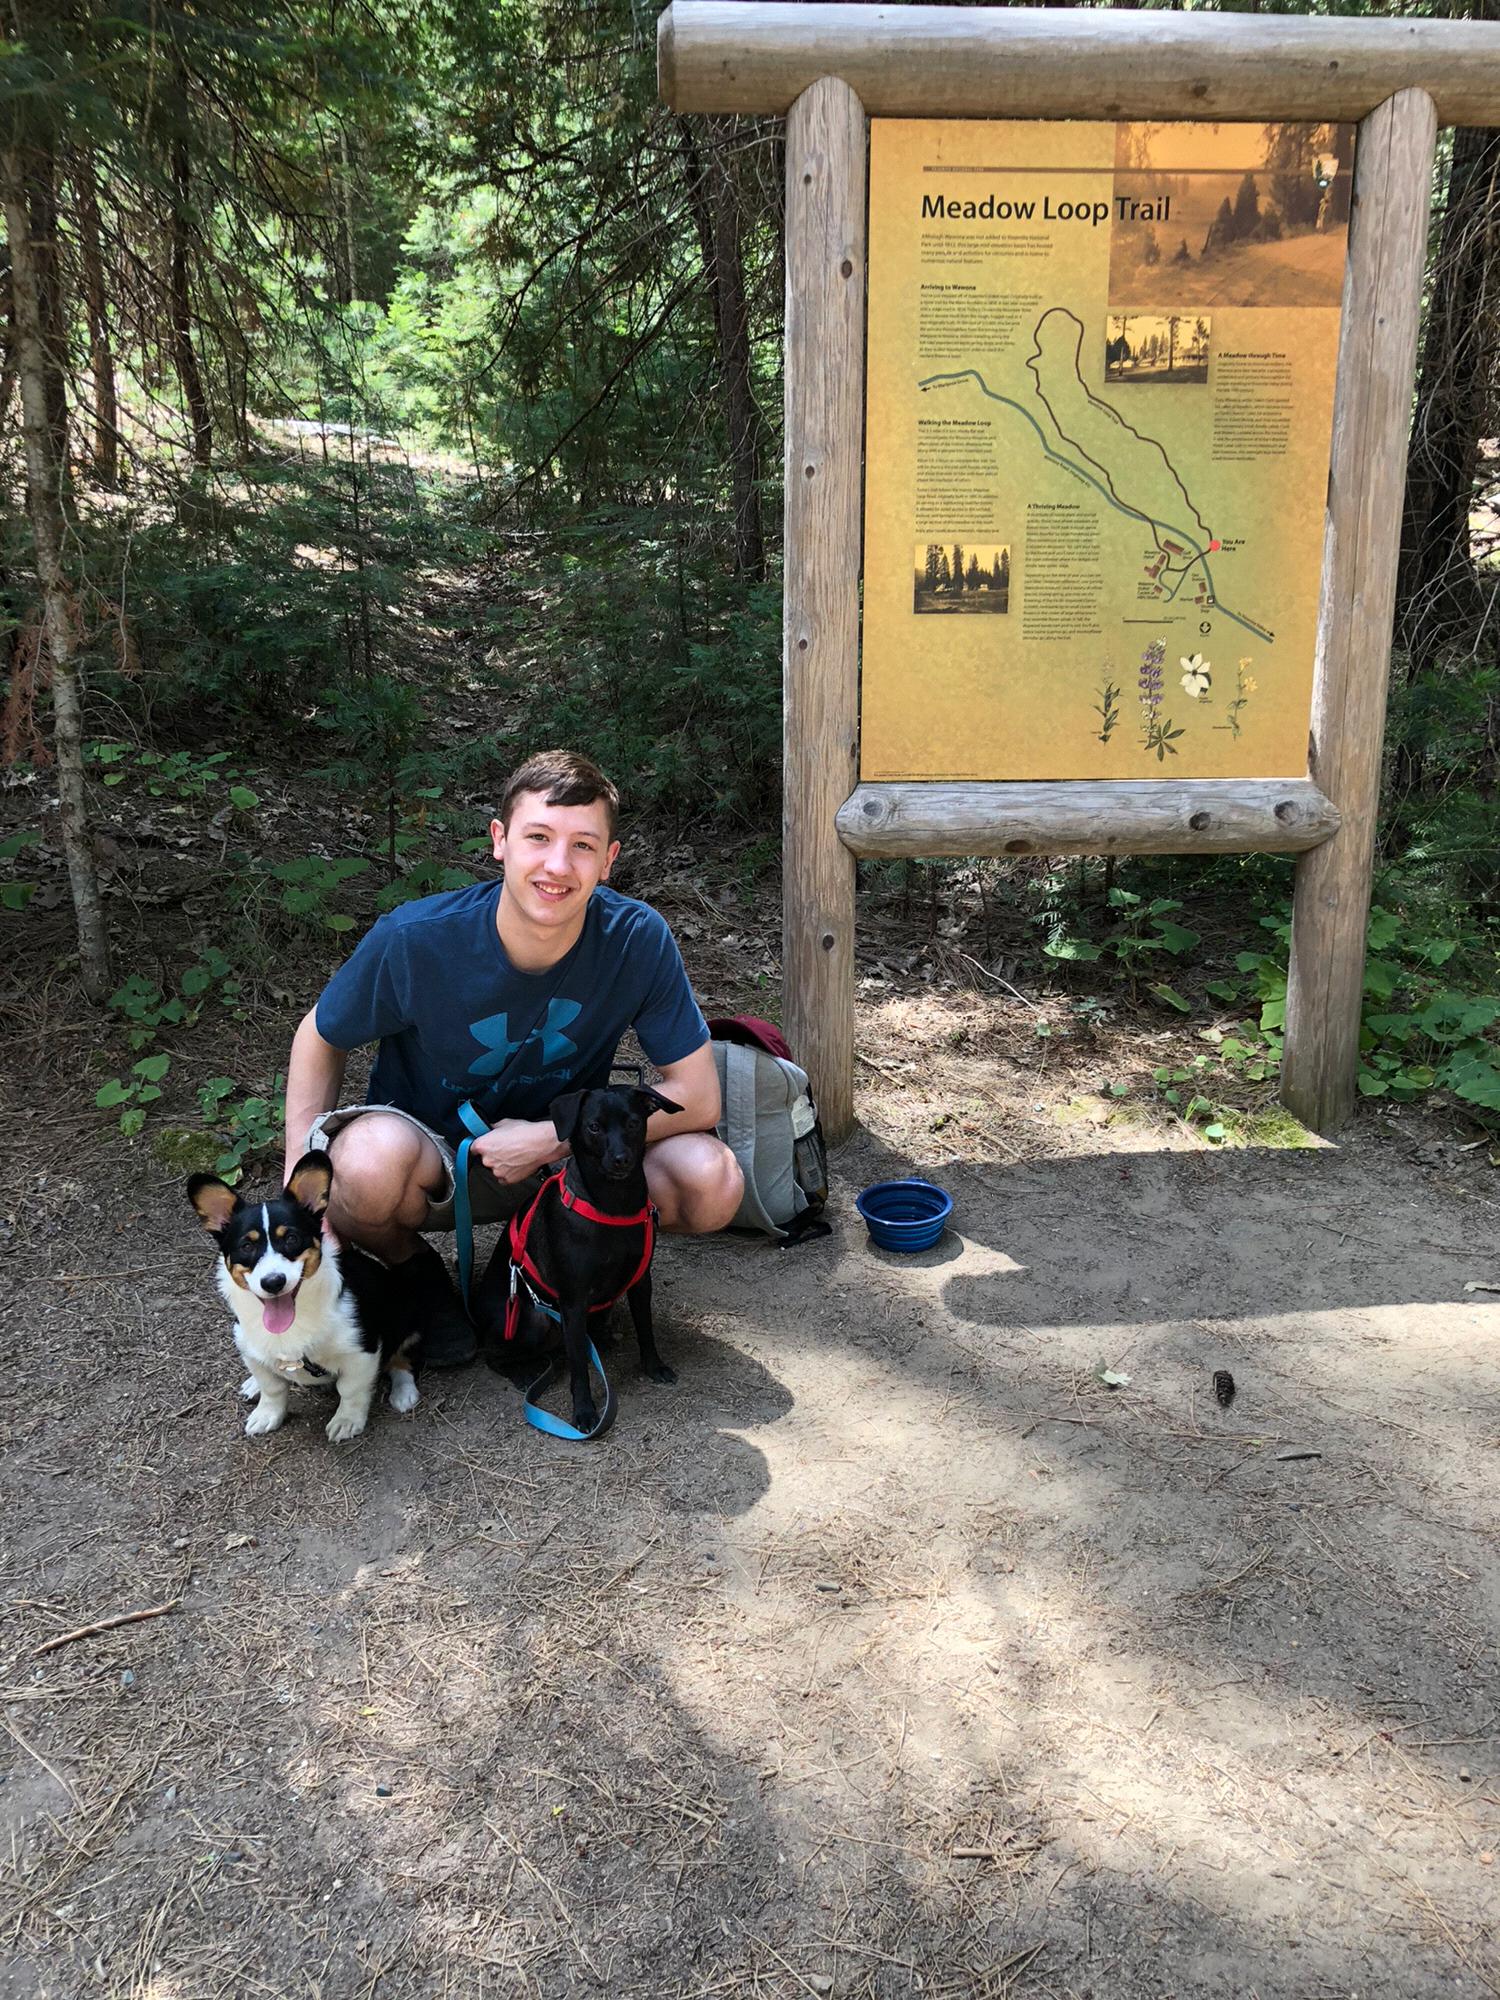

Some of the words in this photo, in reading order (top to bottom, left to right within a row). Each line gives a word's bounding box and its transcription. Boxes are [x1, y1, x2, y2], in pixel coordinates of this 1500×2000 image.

[921, 194, 1036, 220] Meadow
[1043, 195, 1109, 226] Loop
[1114, 195, 1170, 221] Trail
[920, 284, 945, 292] Arriving
[1248, 352, 1271, 360] through
[918, 419, 942, 427] Walking
[977, 419, 992, 427] Loop
[1032, 503, 1056, 511] Thriving
